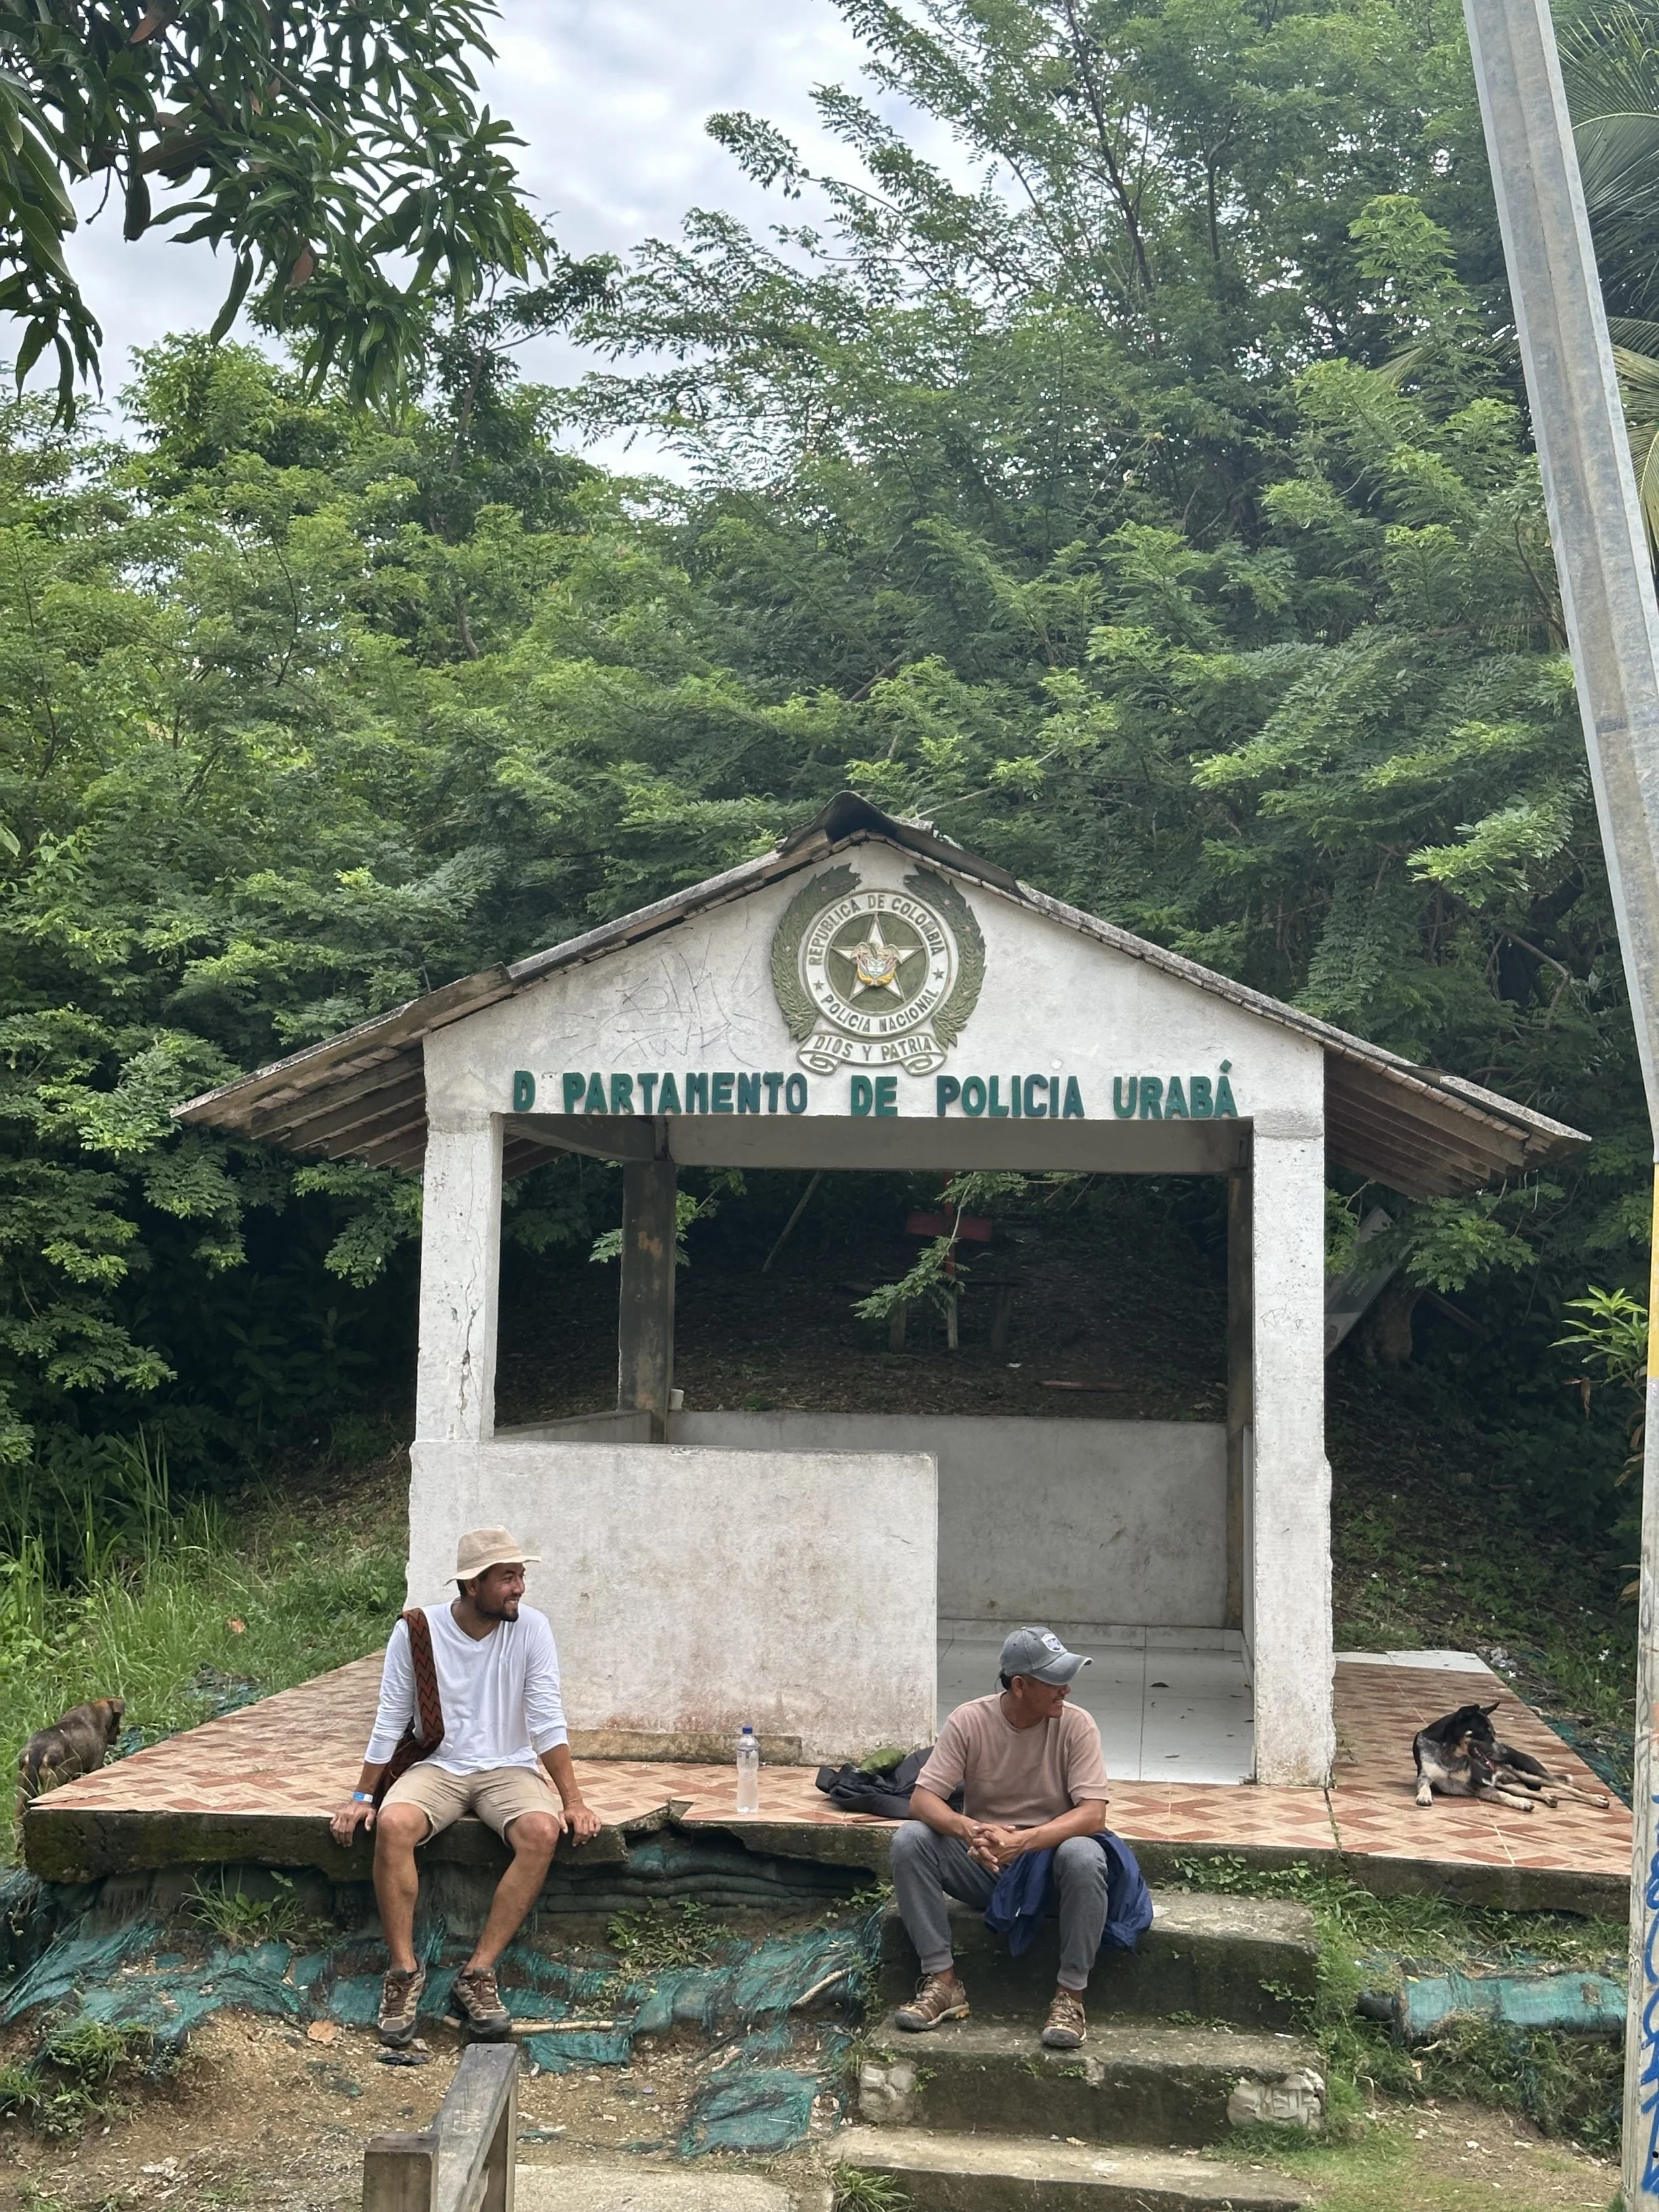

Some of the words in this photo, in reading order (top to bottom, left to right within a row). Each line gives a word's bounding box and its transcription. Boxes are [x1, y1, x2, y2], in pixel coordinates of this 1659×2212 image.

[808, 898, 862, 966] REPUBLICA
[867, 894, 885, 909] DE
[891, 898, 946, 956] COLOMBIA
[820, 993, 871, 1033] POLICIA
[879, 989, 940, 1032] NACIONAL
[813, 1035, 852, 1059] DIOS
[862, 1046, 873, 1061] Y
[881, 1036, 933, 1061] PATRIA
[850, 1074, 899, 1117] DE
[936, 1073, 1086, 1118] POLICIA
[1112, 1059, 1239, 1119] URABÁ
